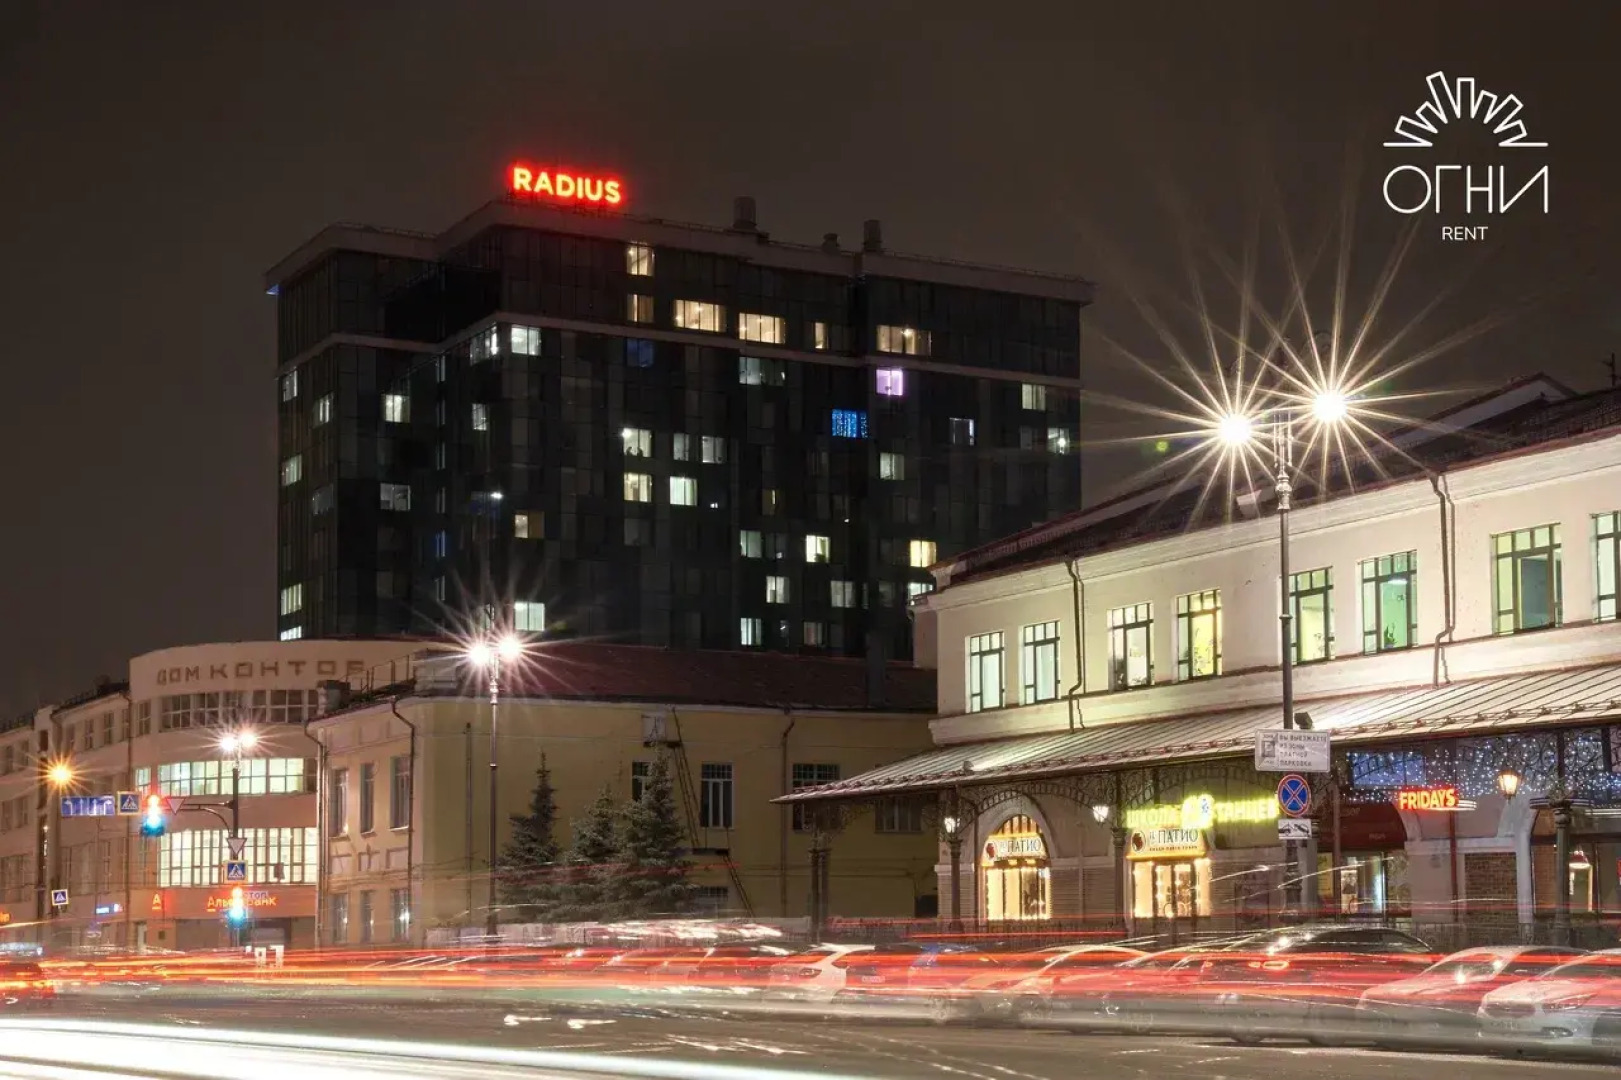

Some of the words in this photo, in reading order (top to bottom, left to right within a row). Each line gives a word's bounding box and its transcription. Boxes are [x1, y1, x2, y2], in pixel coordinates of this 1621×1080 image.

[513, 166, 621, 204] RADIUS
[156, 664, 200, 685] ДОМ
[1158, 828, 1199, 844] ПАТИО
